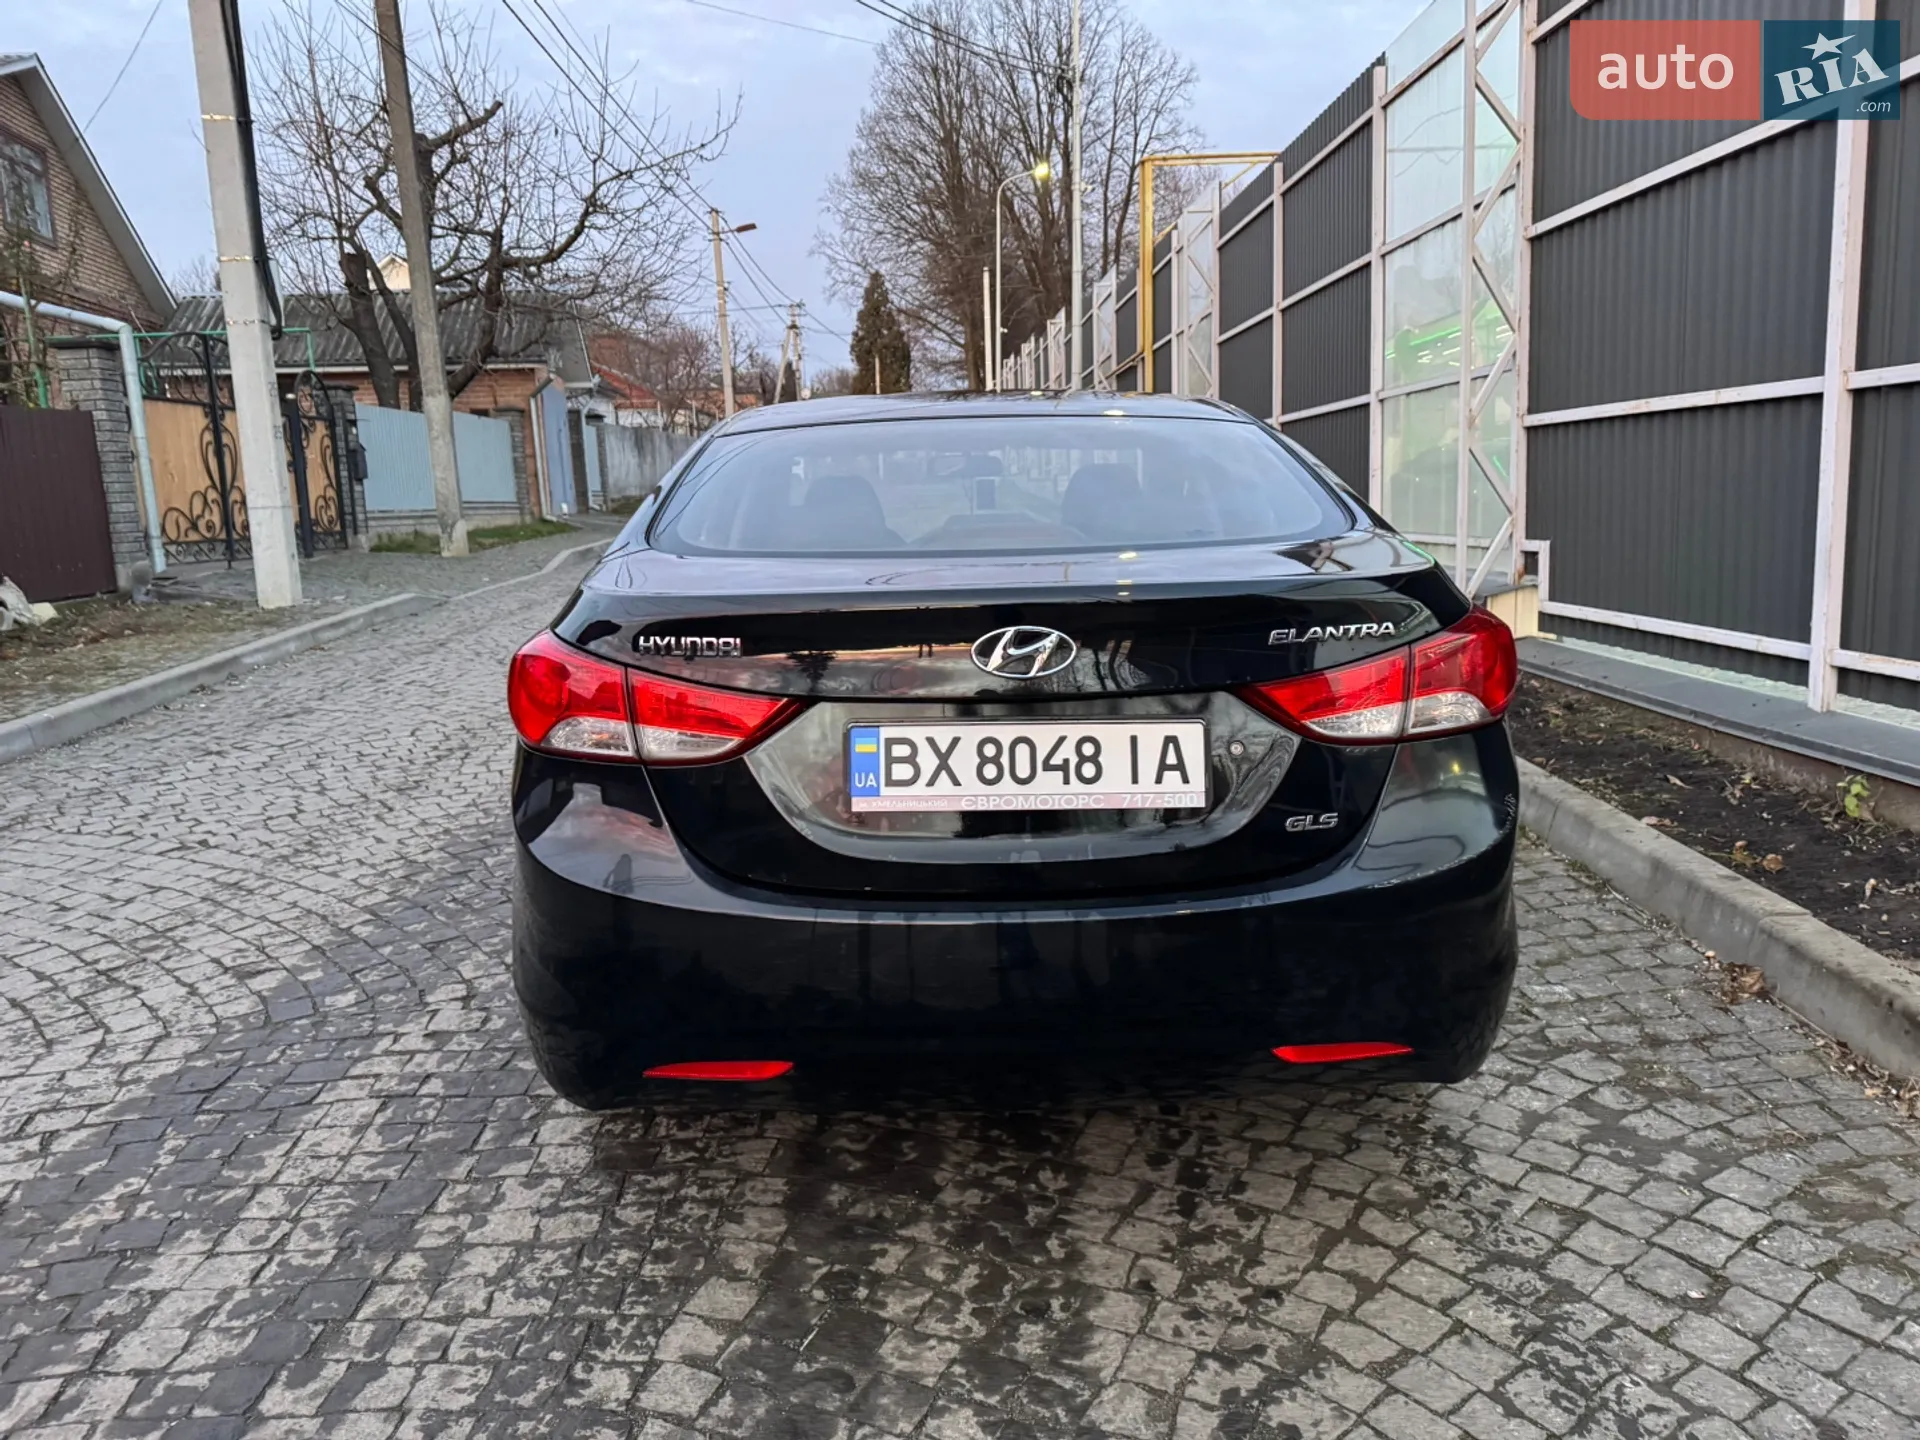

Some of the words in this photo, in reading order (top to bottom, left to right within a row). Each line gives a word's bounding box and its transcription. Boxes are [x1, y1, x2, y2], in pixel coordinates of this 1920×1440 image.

[1268, 621, 1396, 646] ELANTRA
[639, 636, 741, 656] HYUNDAI
[884, 736, 962, 787] BX
[975, 735, 1103, 787] 8048
[1130, 734, 1190, 785] IA
[855, 773, 877, 788] UA
[961, 794, 1104, 809] ЄВРОМОТОРС
[1121, 793, 1197, 808] 717-500
[1285, 812, 1339, 832] GLS
